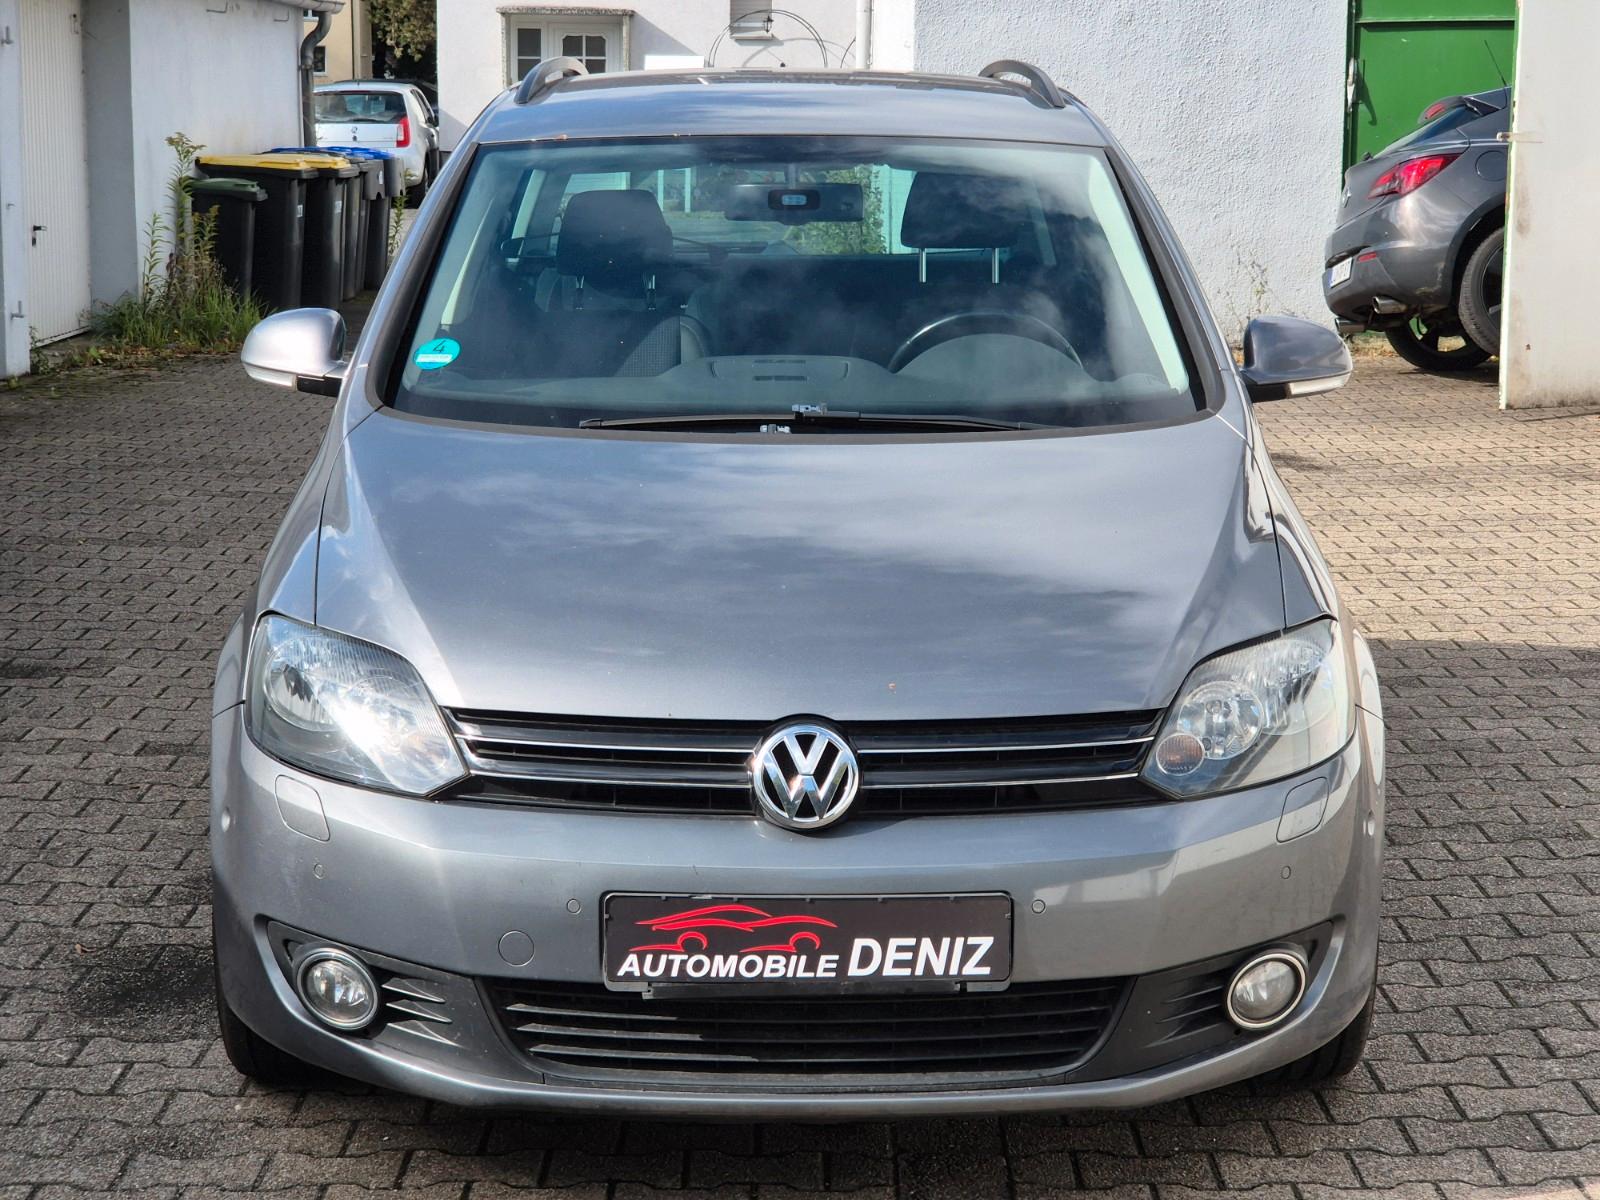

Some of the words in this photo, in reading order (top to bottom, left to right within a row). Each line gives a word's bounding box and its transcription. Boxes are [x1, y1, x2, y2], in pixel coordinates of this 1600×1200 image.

[432, 340, 447, 353] 4
[758, 727, 856, 825] VW
[617, 953, 840, 979] AUTOMOBILE
[847, 936, 994, 977] DENIZ
